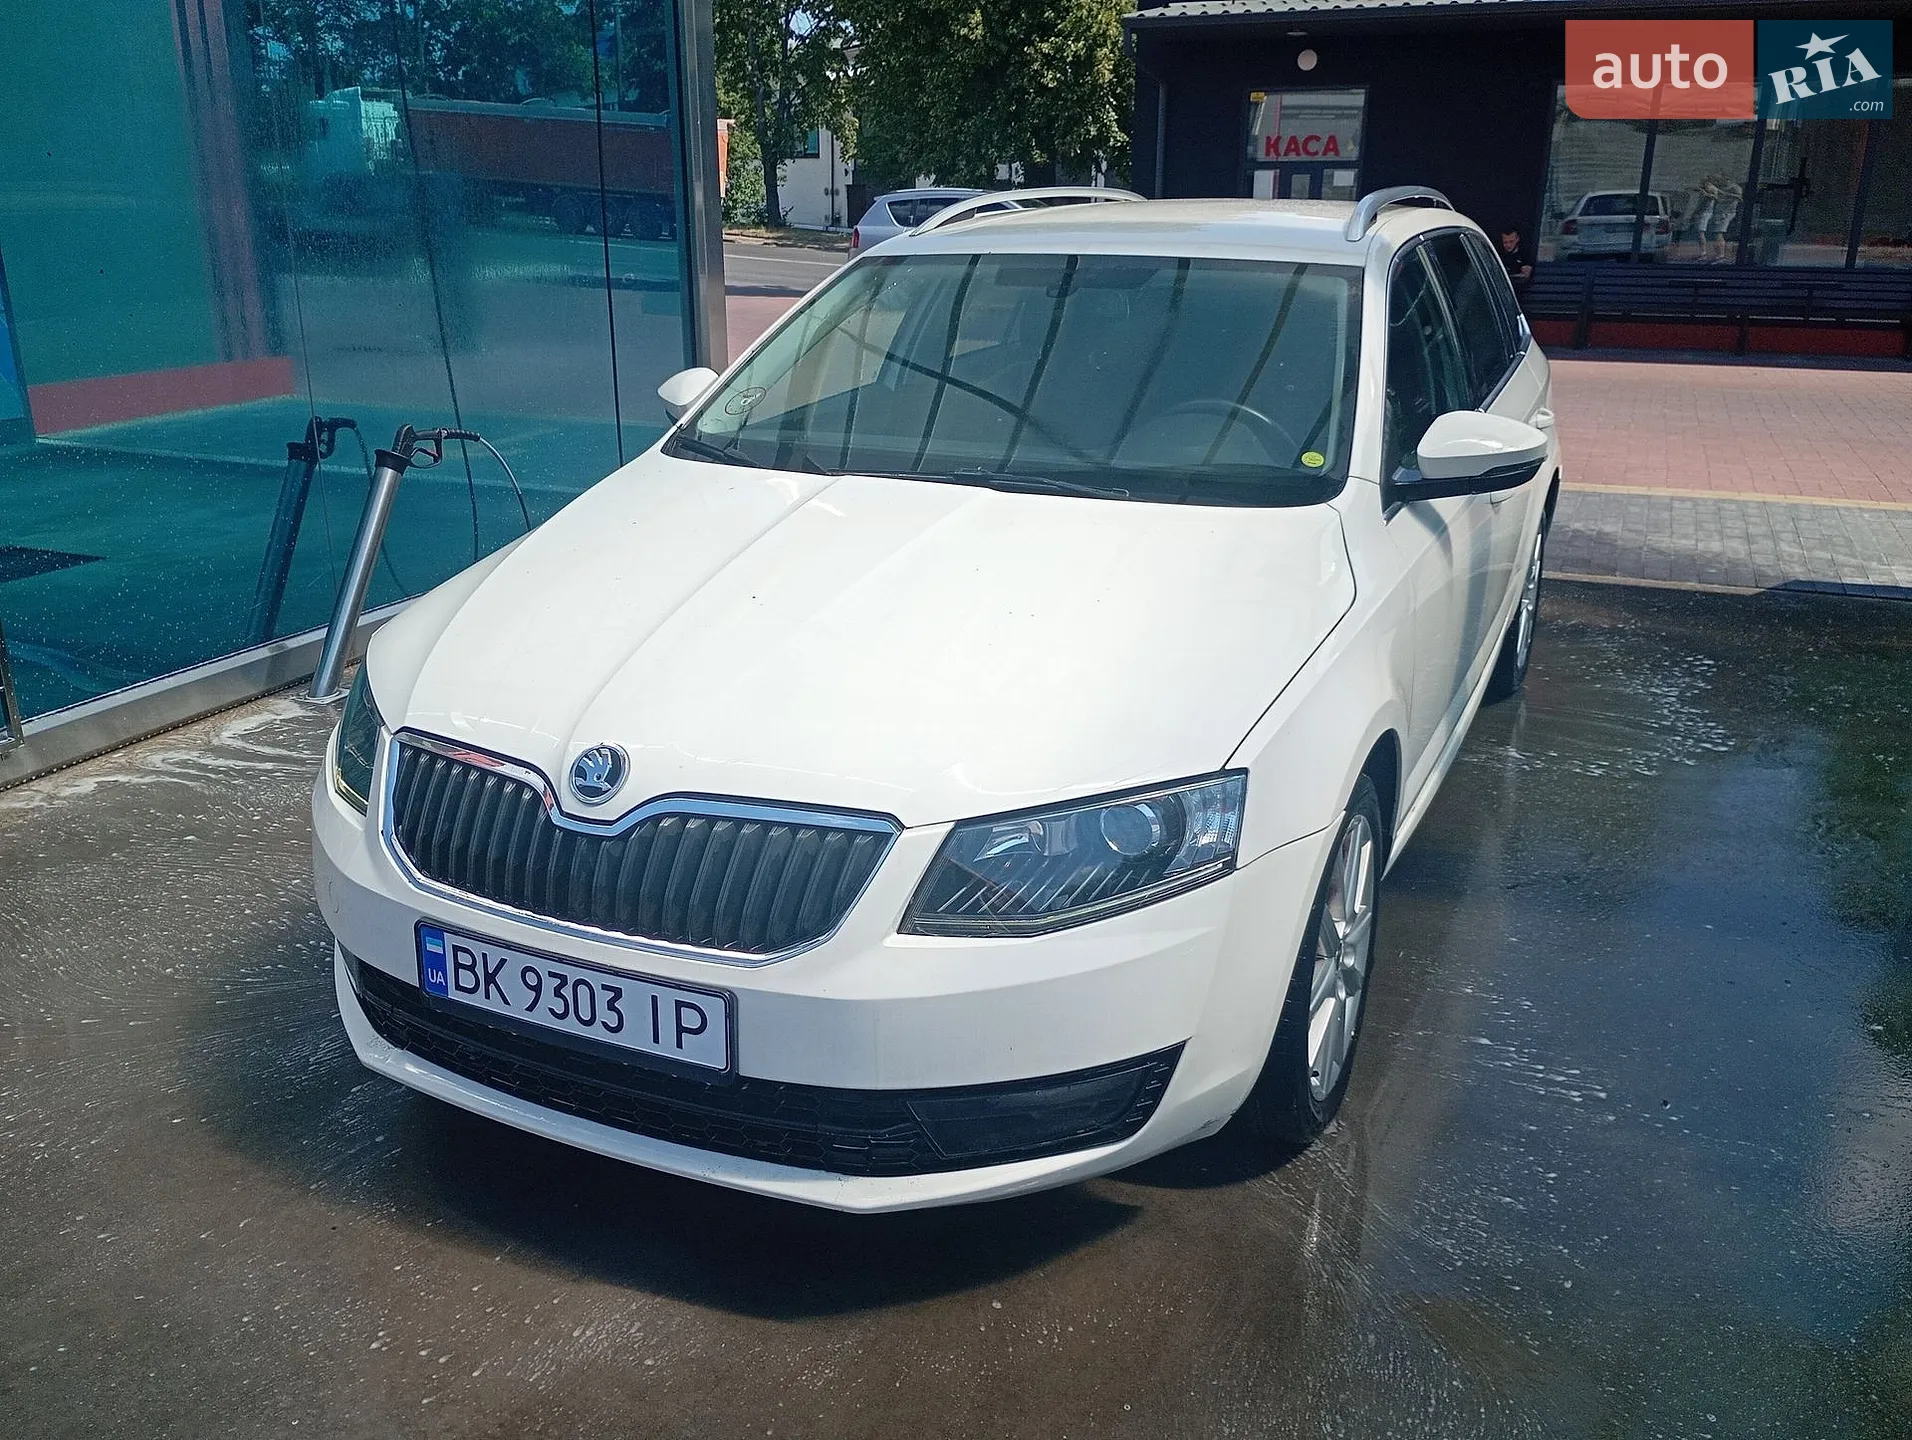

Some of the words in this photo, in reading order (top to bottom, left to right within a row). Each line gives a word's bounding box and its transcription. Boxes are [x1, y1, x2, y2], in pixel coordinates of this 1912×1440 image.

[1264, 134, 1340, 157] КАСА
[428, 967, 446, 986] UA
[451, 943, 512, 1007] BK
[520, 964, 625, 1035] 9303
[650, 993, 709, 1051] IP
